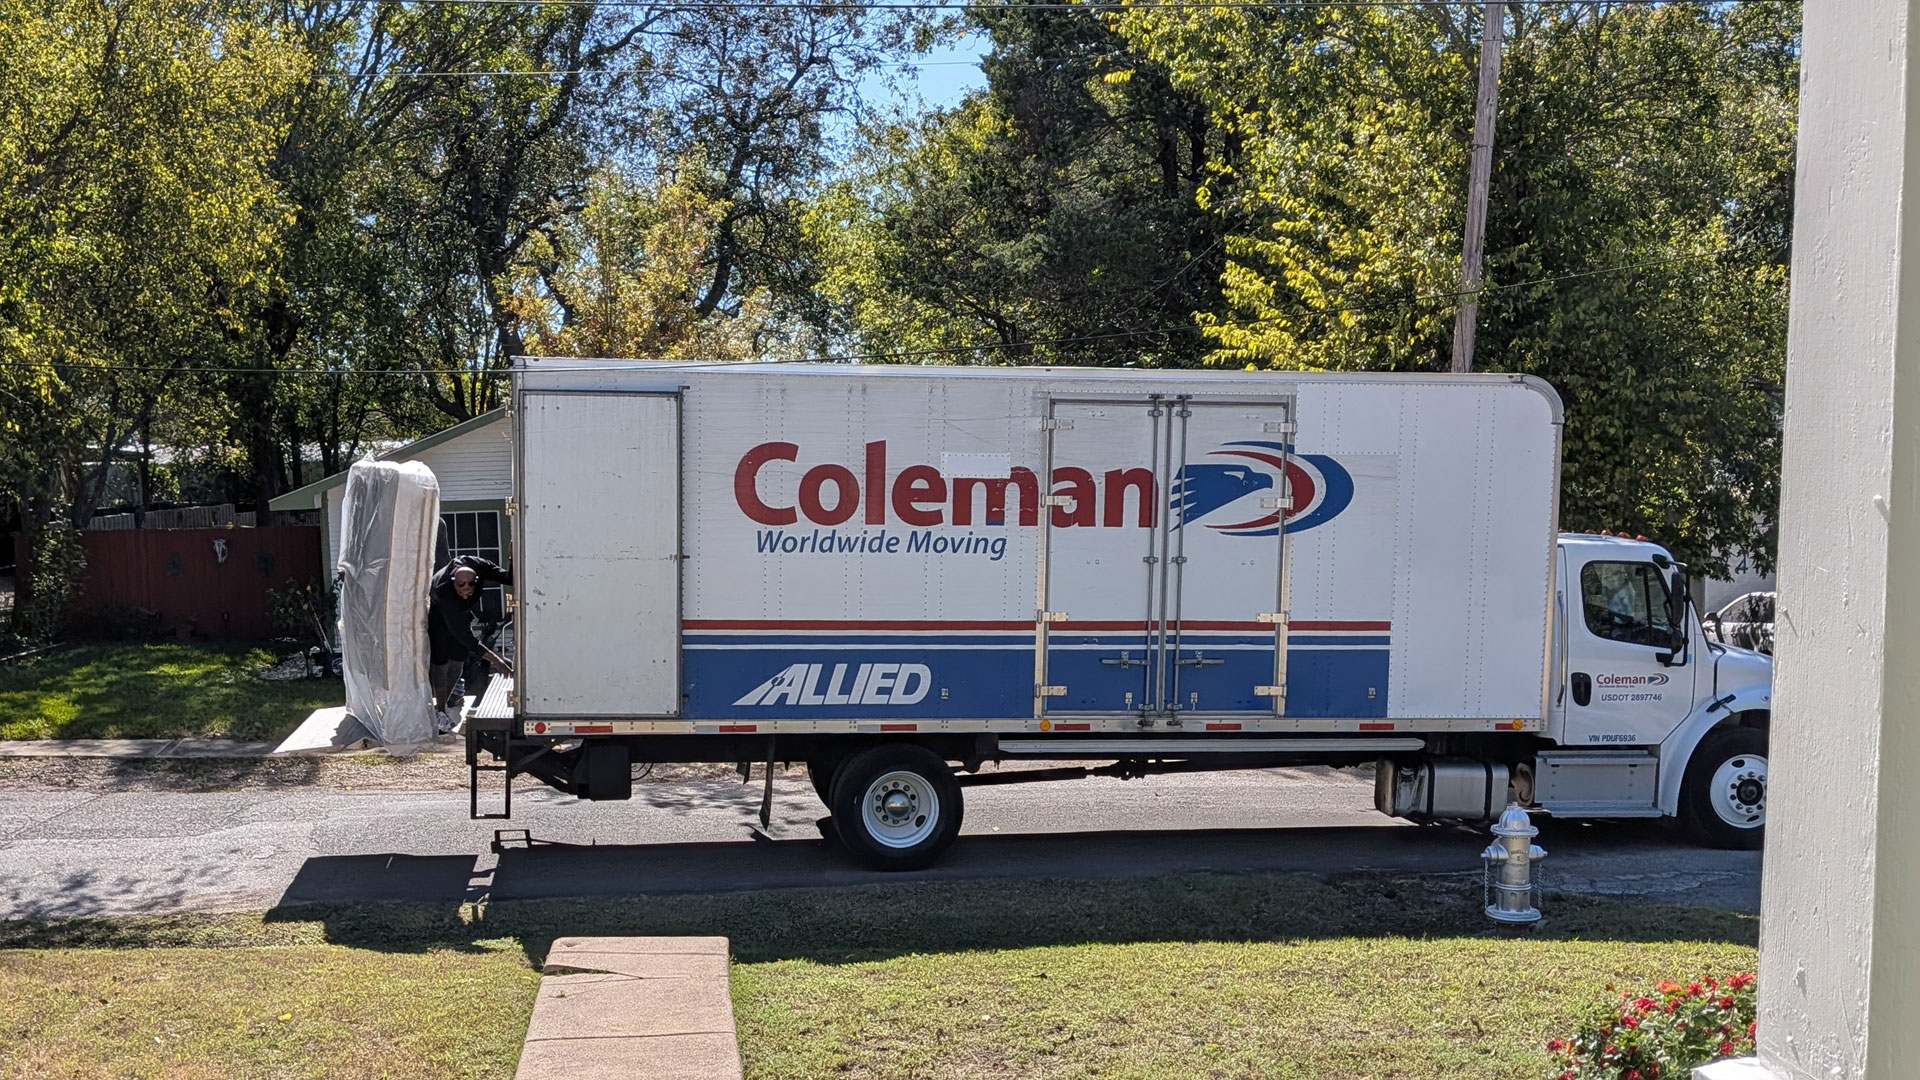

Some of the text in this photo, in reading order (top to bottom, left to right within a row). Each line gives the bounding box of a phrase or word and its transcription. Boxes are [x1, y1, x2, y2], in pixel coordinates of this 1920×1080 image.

[734, 440, 1159, 528] Coleman
[757, 529, 1007, 561] Worldwide Moving
[732, 663, 931, 706] ALLIED
[1596, 673, 1646, 684] Coleman
[1601, 693, 1662, 701] USDOT 2897746
[1588, 734, 1600, 742] VIN
